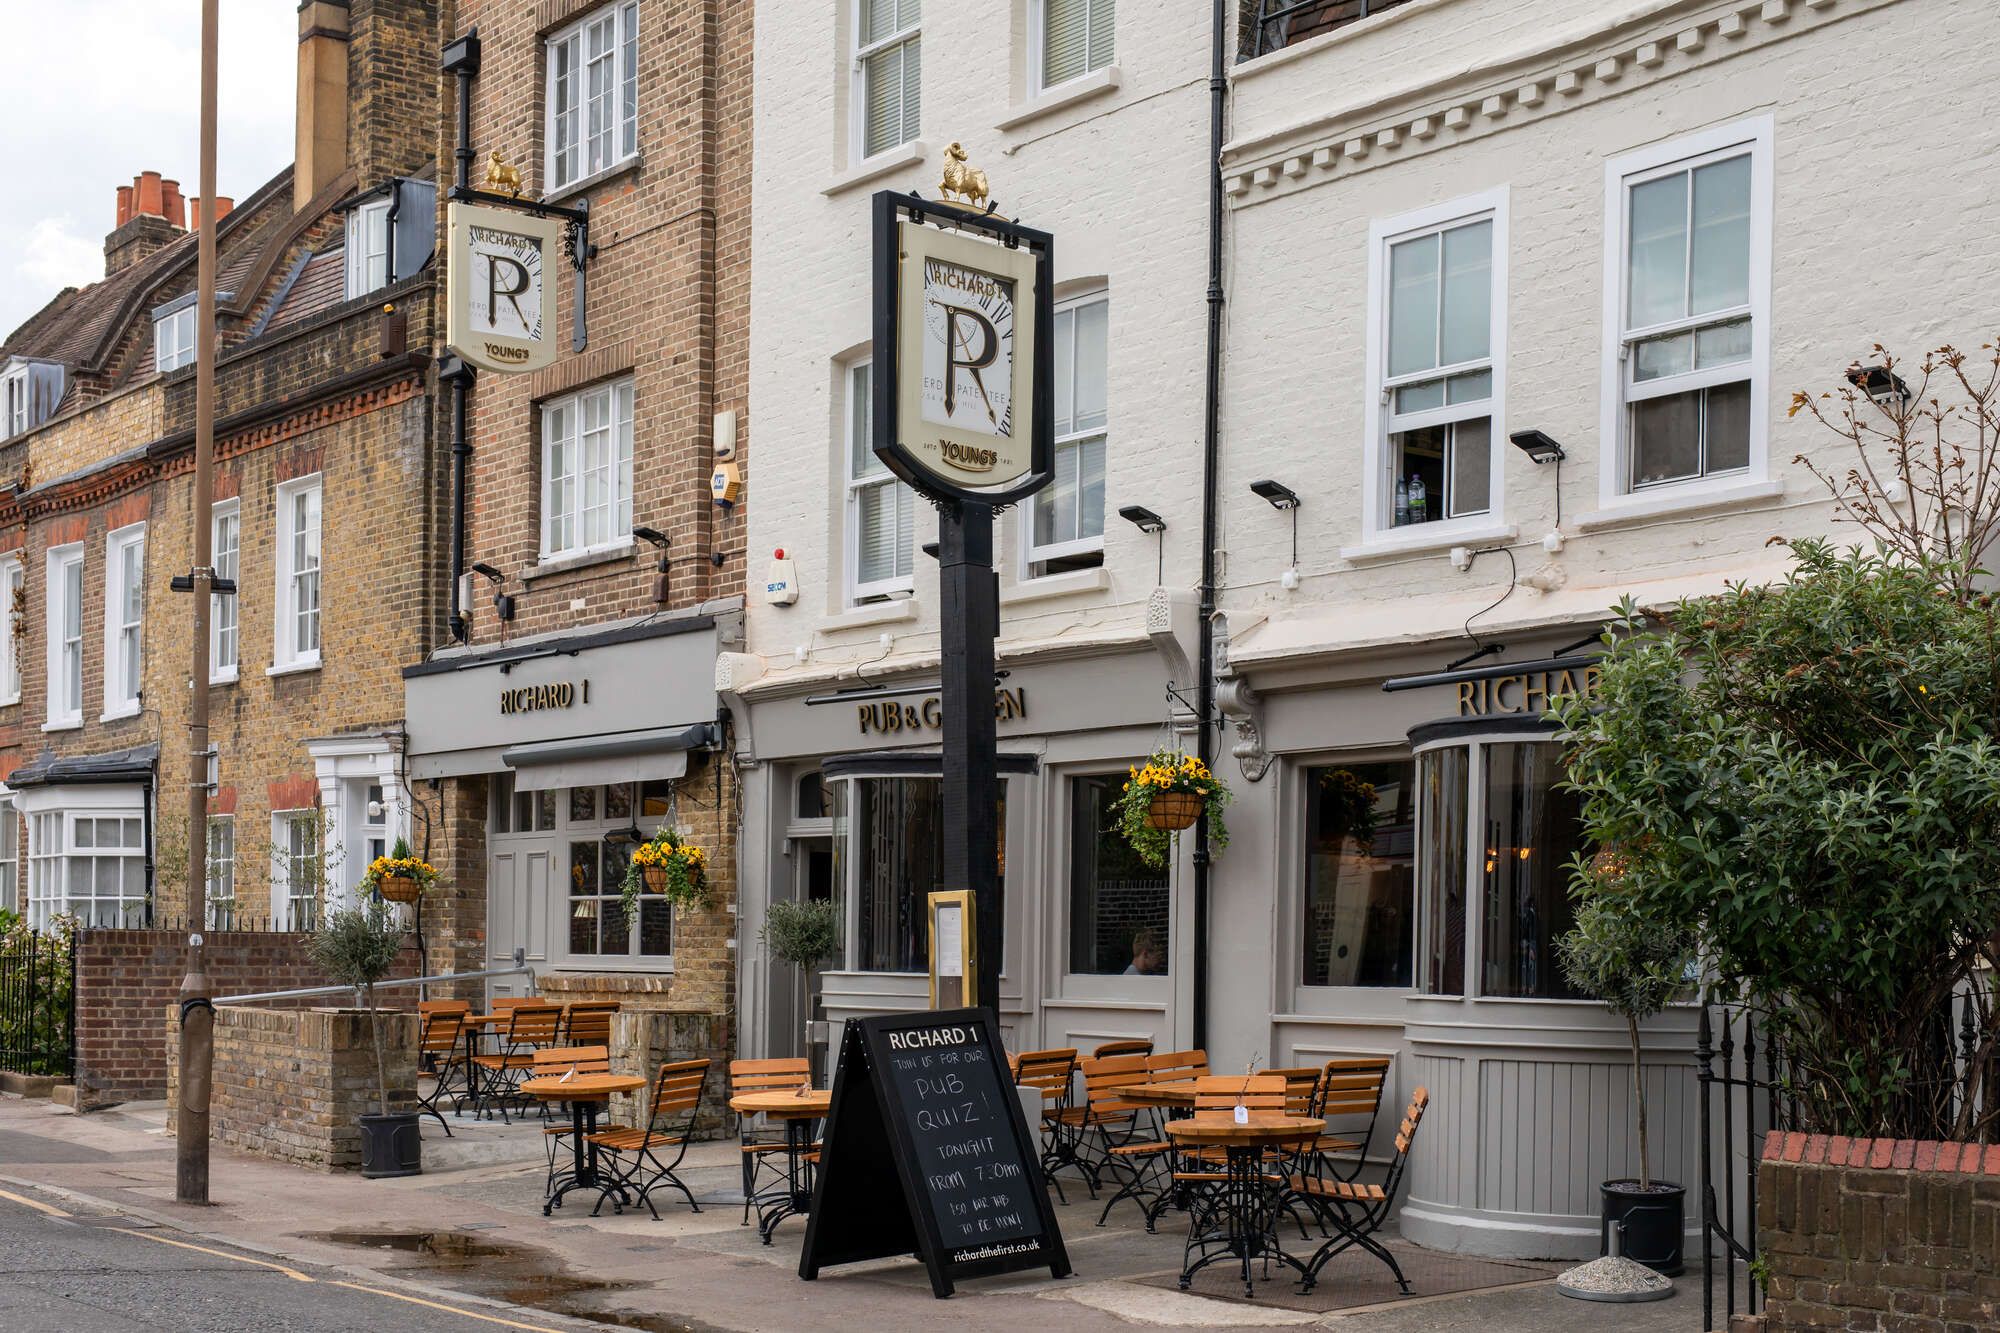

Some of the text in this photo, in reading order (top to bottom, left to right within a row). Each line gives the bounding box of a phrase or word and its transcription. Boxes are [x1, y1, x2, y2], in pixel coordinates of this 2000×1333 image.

[933, 270, 996, 297] RICHARD
[484, 342, 530, 359] YOUNG'S
[940, 439, 999, 466] YOUNG'S
[501, 681, 574, 715] RICHARD
[857, 687, 1025, 734] PUB & GEN
[888, 1026, 979, 1050] RICHARD 1
[940, 1052, 960, 1065] FOR
[964, 1049, 985, 1063] OUR
[913, 1073, 965, 1100] PUB
[953, 1238, 1041, 1263] richardthefirst.co.uk
